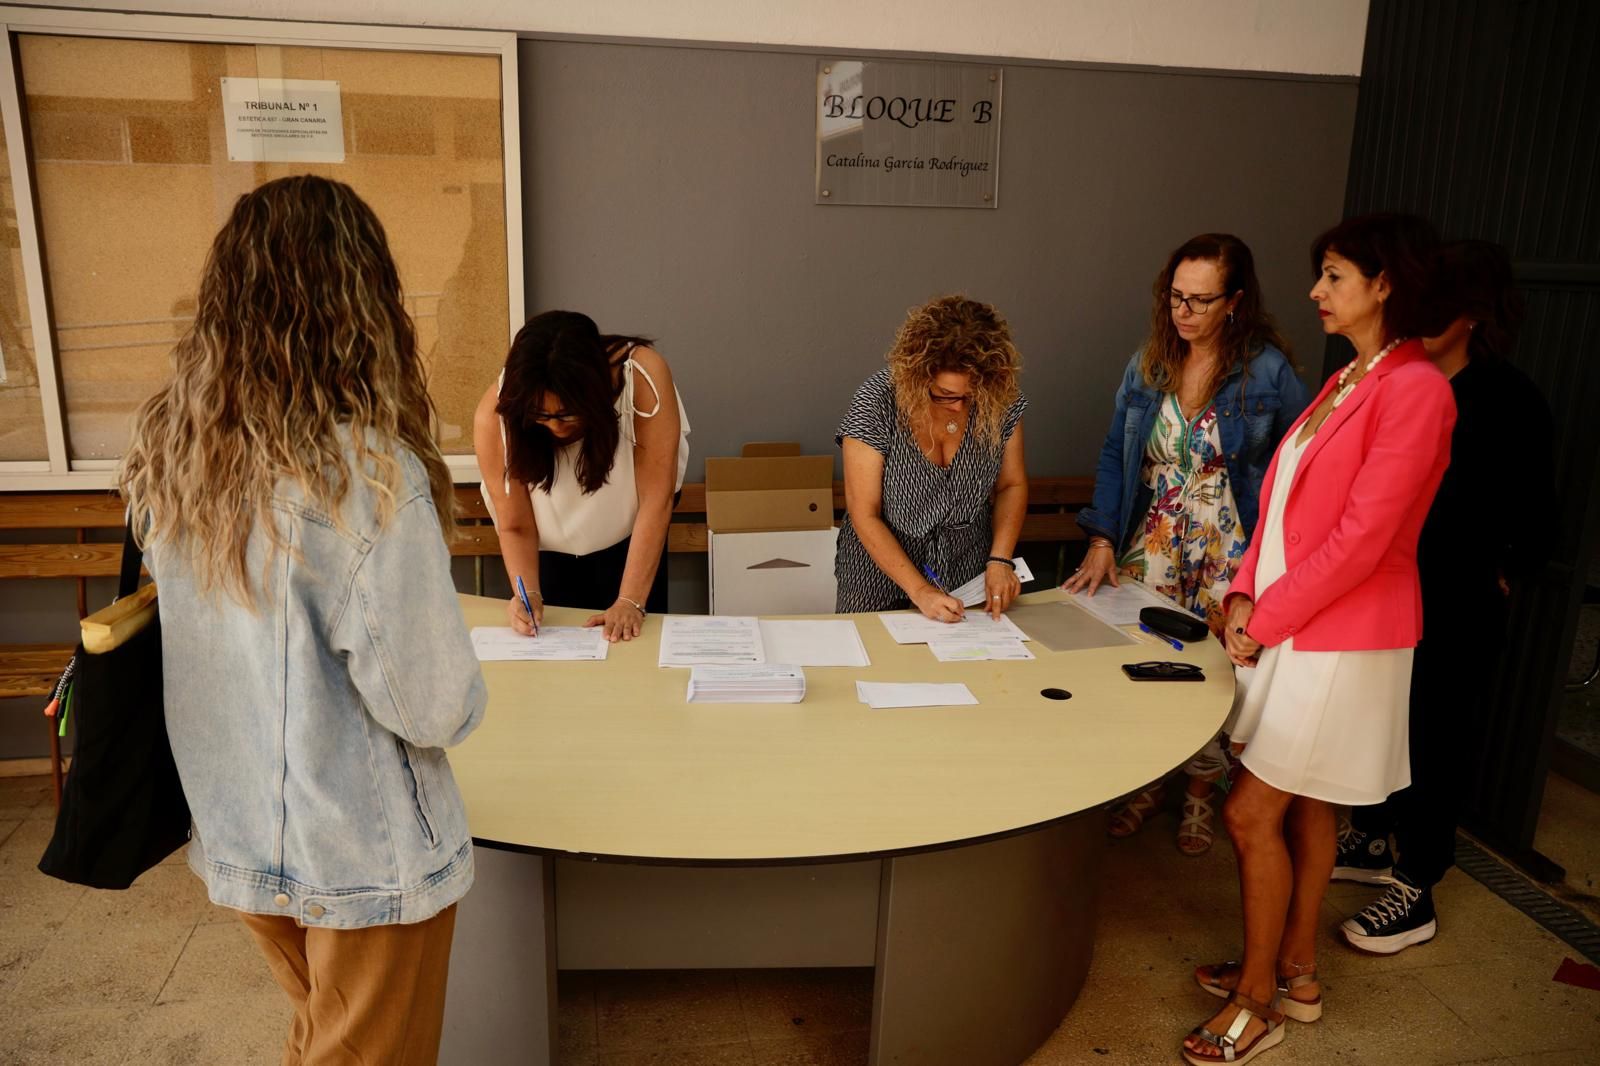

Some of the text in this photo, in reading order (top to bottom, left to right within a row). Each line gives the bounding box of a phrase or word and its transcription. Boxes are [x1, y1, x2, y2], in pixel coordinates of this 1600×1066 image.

[244, 101, 296, 111] TRIBUNAL
[312, 103, 318, 111] 1
[824, 95, 992, 128] BLOQUE B
[826, 152, 880, 168] Catalina
